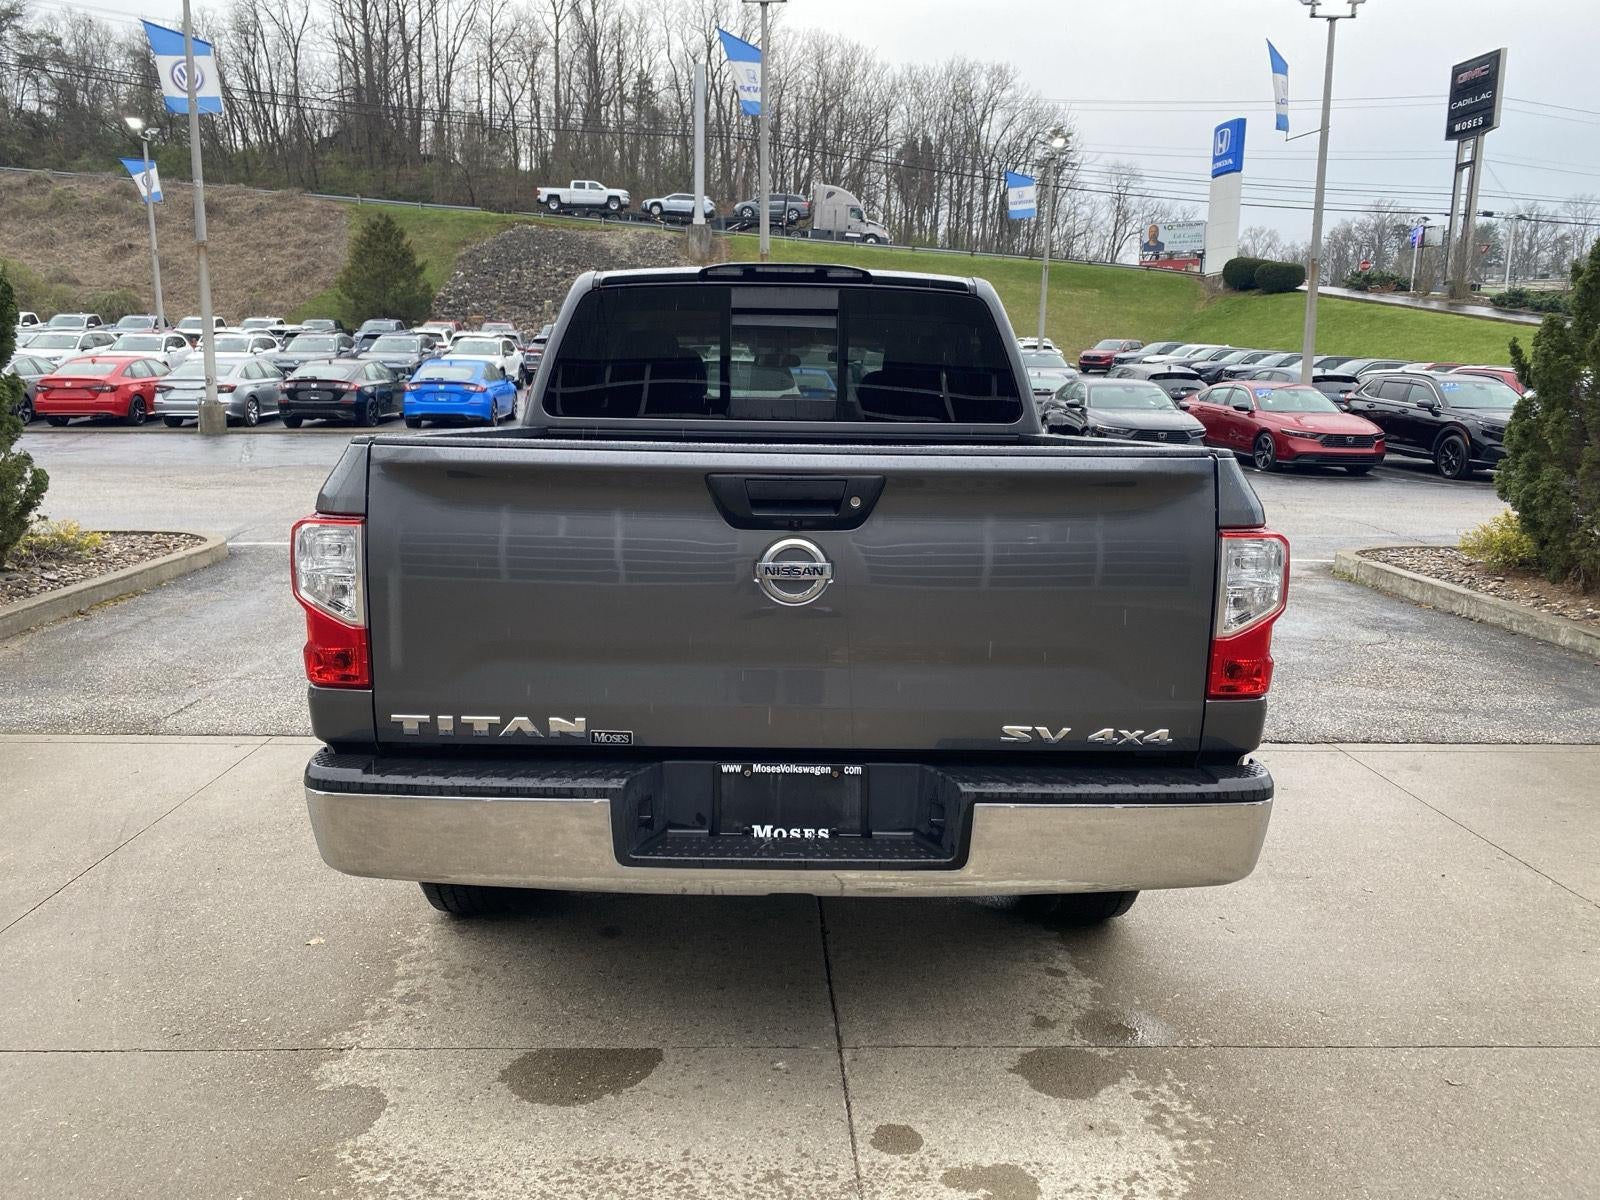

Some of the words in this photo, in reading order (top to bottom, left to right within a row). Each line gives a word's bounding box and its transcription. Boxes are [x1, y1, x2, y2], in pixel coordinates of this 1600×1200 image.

[1456, 64, 1490, 84] GMC
[1451, 91, 1492, 110] CADILLAC
[1454, 116, 1484, 132] MOSES
[764, 566, 824, 576] NISSAN
[390, 714, 587, 738] TITAN
[1000, 725, 1072, 744] SV
[721, 764, 742, 773] www
[752, 763, 831, 776] MosesVolkswagen
[843, 766, 862, 775] com
